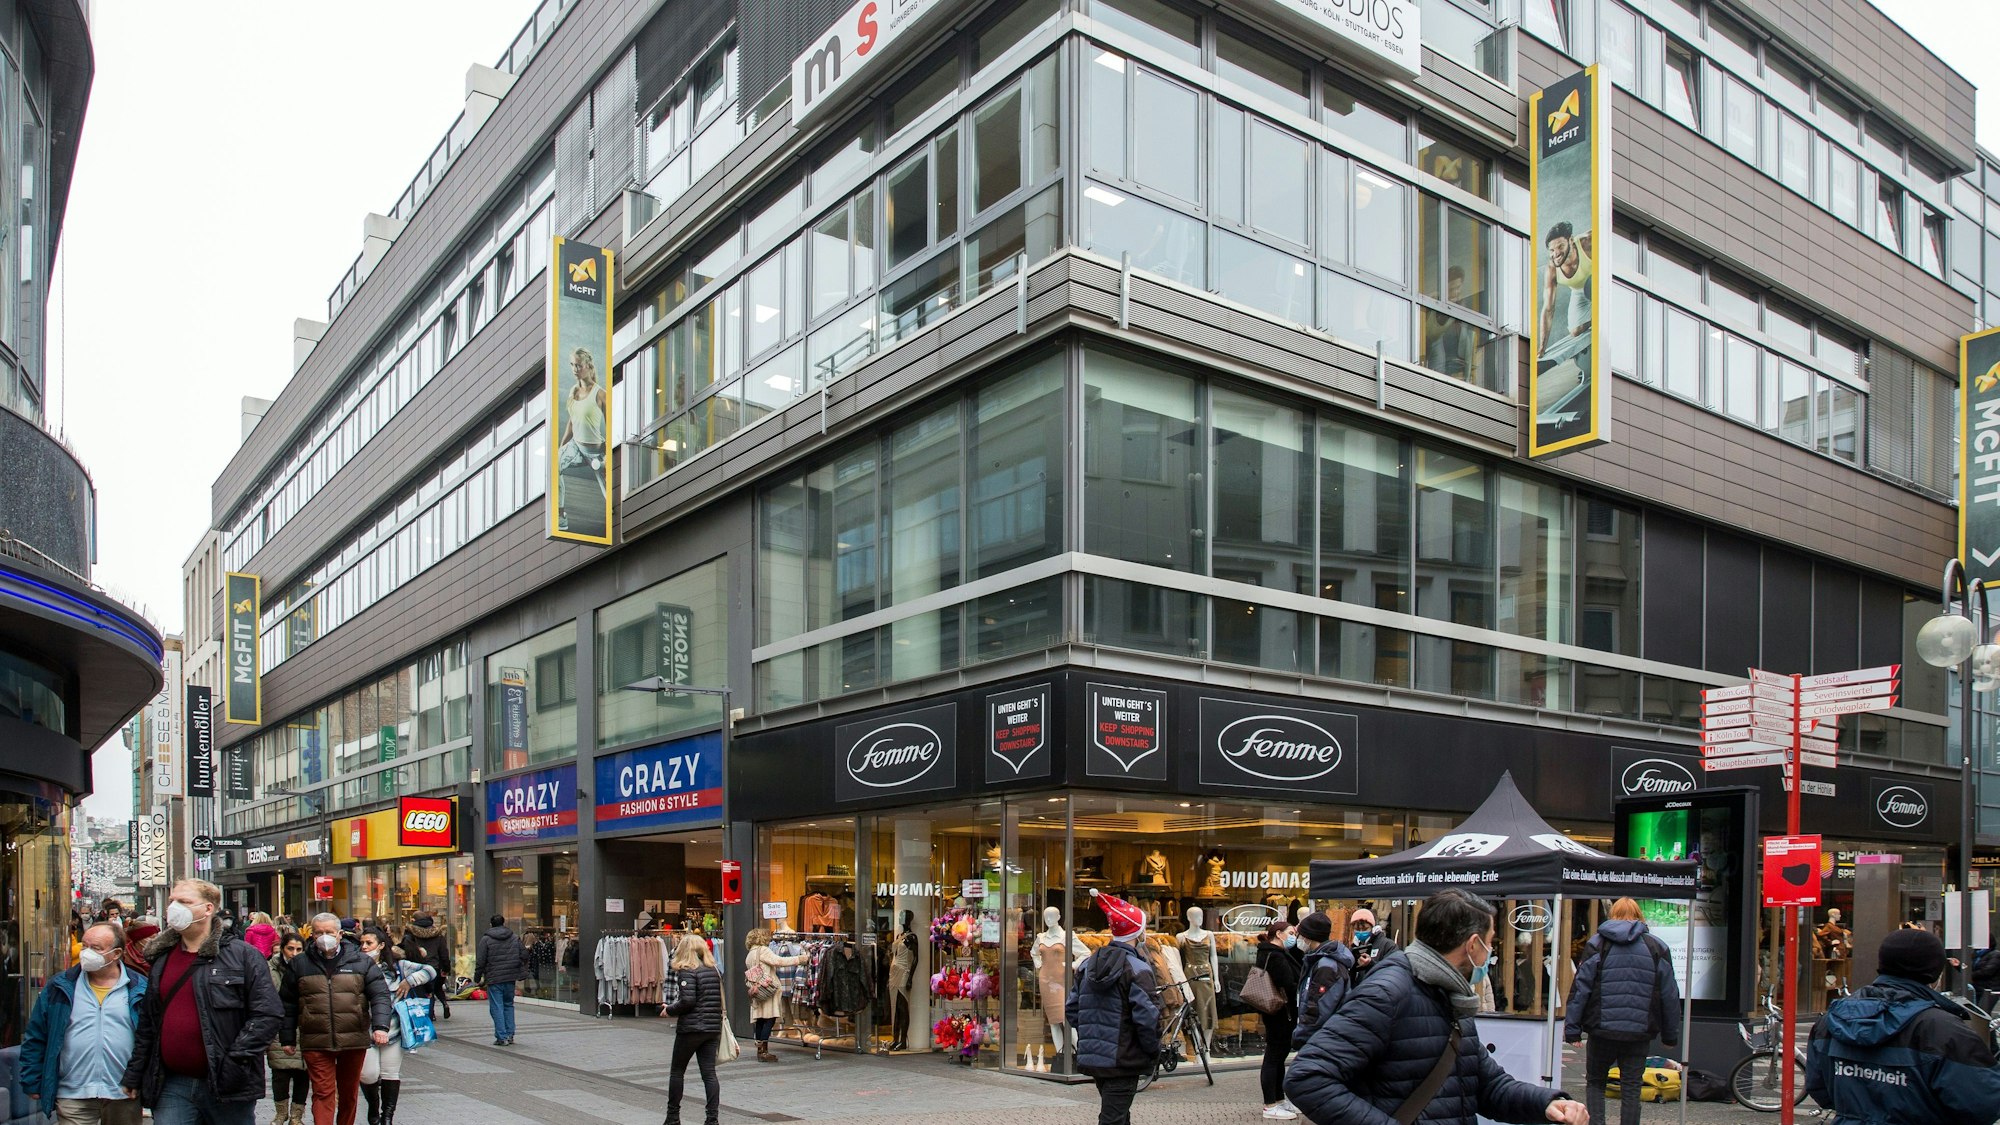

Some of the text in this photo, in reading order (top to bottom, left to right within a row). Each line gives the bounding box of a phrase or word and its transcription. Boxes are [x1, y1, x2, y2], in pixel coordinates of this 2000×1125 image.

[889, 1, 918, 31] NÜRNBERG
[1323, 7, 1340, 22] KÖLN
[1345, 18, 1380, 43] STUTTGART
[1384, 39, 1404, 55] ESSEN
[1548, 126, 1579, 149] McFIT
[569, 283, 596, 296] McFIT
[234, 619, 252, 683] McFIT
[1814, 674, 1849, 685] Südstadt
[1814, 686, 1873, 699] Severinsviertel
[997, 702, 1016, 714] UNTEN
[1102, 696, 1125, 708] UNTEN
[1813, 703, 1871, 715] Chlodwigplatz
[1007, 713, 1028, 725] WEITER
[1114, 710, 1140, 722] WEITER
[1716, 717, 1748, 726] Museum
[995, 724, 1040, 739] KEEP SHOPPING
[1099, 722, 1154, 737] KEEP SHOPPING
[1716, 731, 1734, 740] Köln
[193, 695, 211, 789] hunkemöller
[1000, 738, 1036, 751] DOWNSTAIRS
[1105, 736, 1149, 749] DOWNSTAIRS
[1716, 756, 1768, 768] Hauptbahnhof
[620, 752, 700, 797] CRAZY
[1807, 783, 1816, 793] der
[1817, 784, 1832, 795] Höhle
[503, 781, 560, 816] CRAZY
[620, 793, 698, 816] FASHION & STYLE
[404, 810, 450, 833] LEGO
[503, 813, 559, 832] FASHION & STYLE
[140, 822, 152, 880] MANGO
[152, 813, 166, 878] MANGO
[1357, 870, 1499, 885] Gemeinsam aktiv für eine lebendige Erde
[1562, 867, 1571, 879] Für
[1571, 869, 1580, 880] eine
